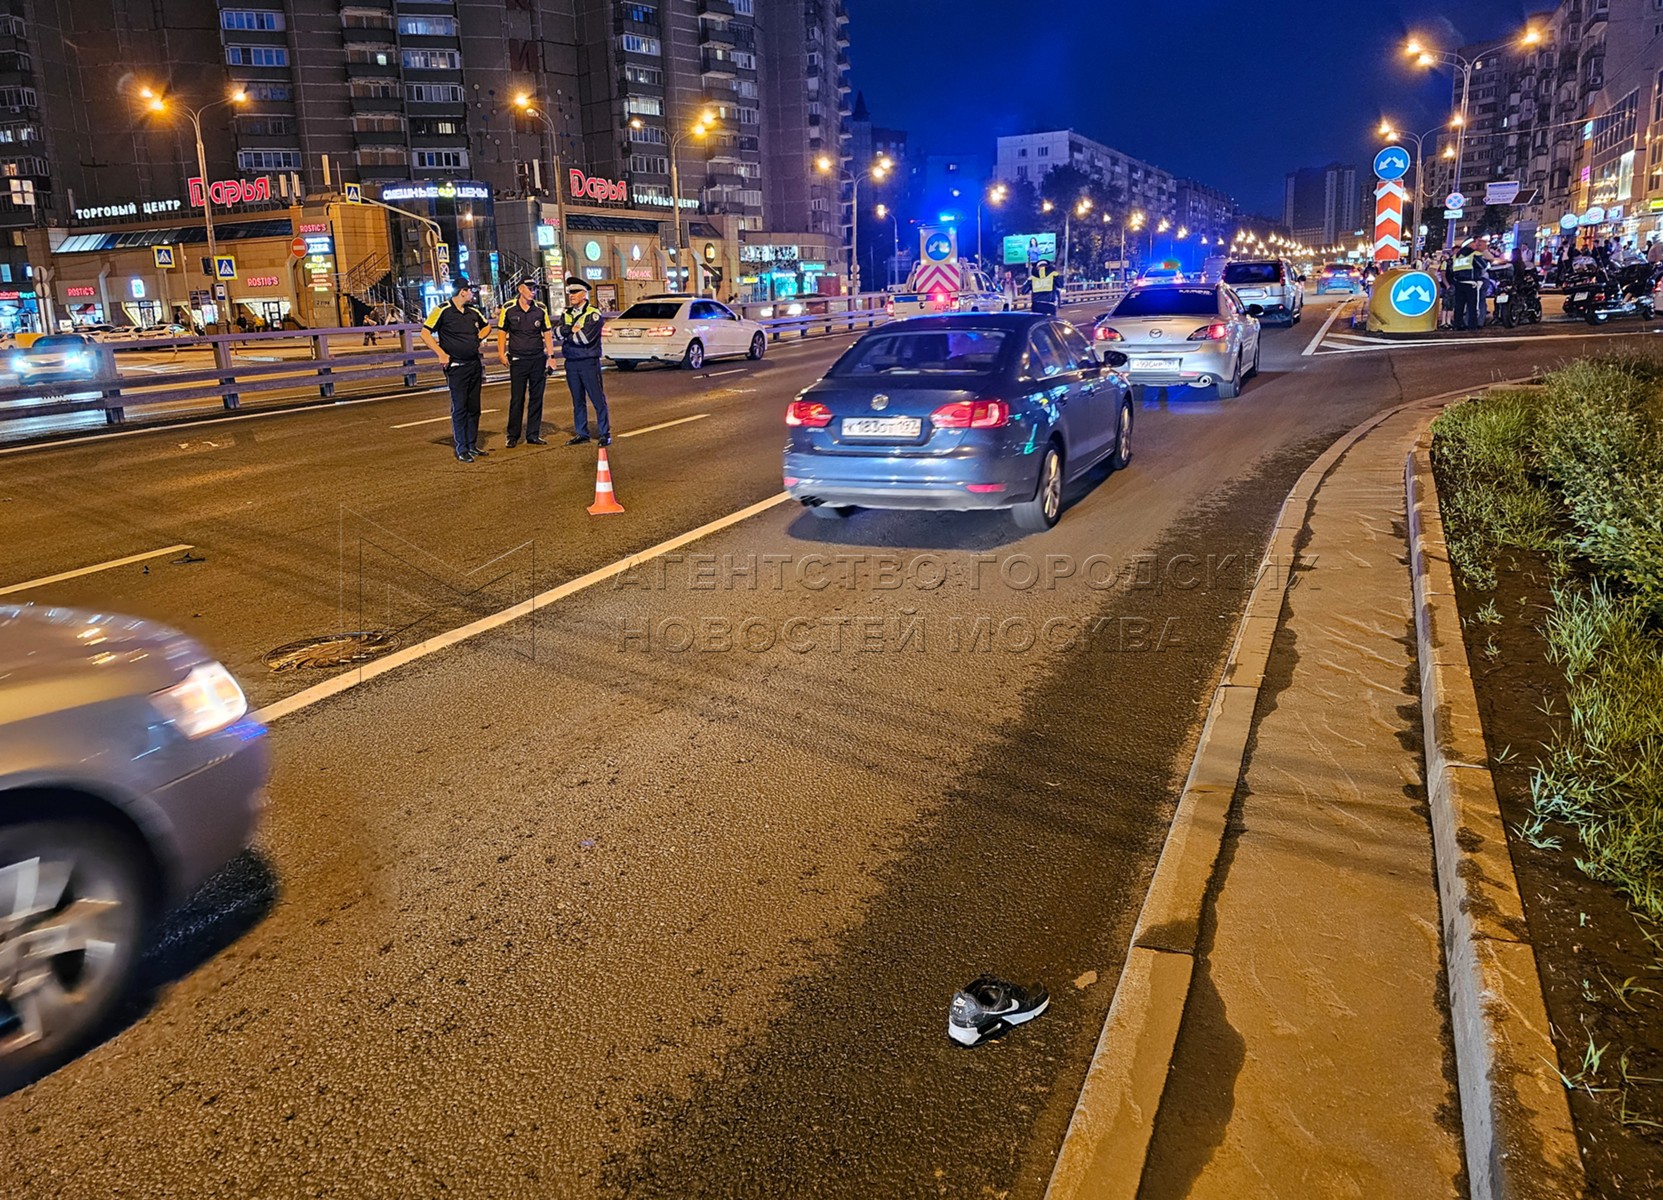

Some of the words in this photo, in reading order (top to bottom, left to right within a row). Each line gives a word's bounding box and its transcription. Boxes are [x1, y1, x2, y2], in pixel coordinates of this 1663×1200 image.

[569, 168, 627, 203] Дарья
[632, 194, 674, 206] ТОРГОВЫЙ
[678, 198, 700, 209] ЦЕНТР
[75, 201, 137, 219] ТОРГОВЫЙ
[143, 200, 181, 214] ЦЕНТР
[300, 223, 326, 233] ROSTIC'S
[247, 277, 279, 287] ROSTIC'S
[67, 287, 95, 297] ROSTIC'S
